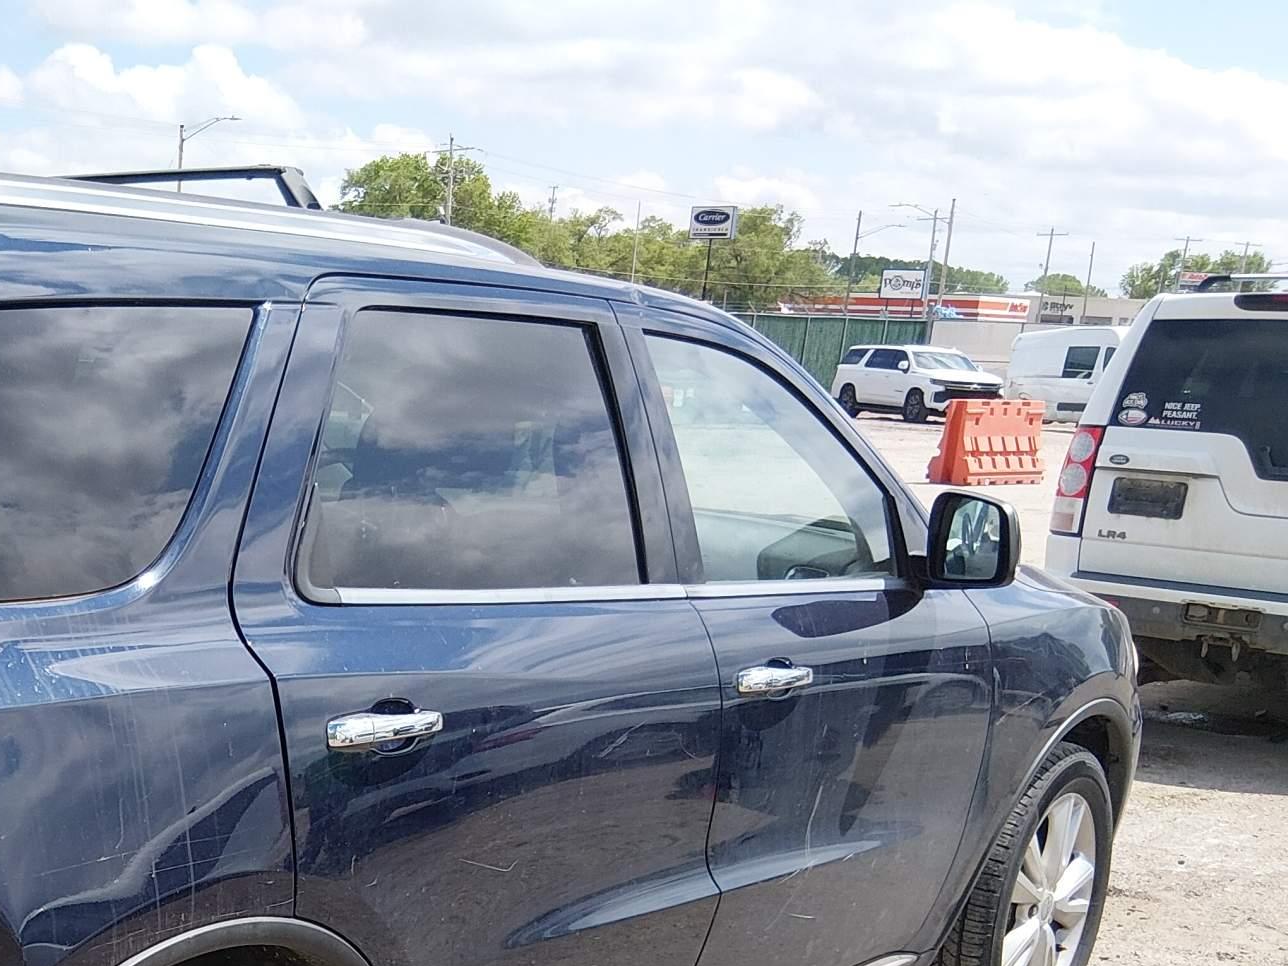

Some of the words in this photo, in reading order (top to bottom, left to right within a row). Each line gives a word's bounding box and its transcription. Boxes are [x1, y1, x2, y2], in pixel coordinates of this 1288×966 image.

[698, 212, 727, 222] Carrier
[1164, 402, 1182, 410] NICE
[1097, 529, 1127, 540] LR4
